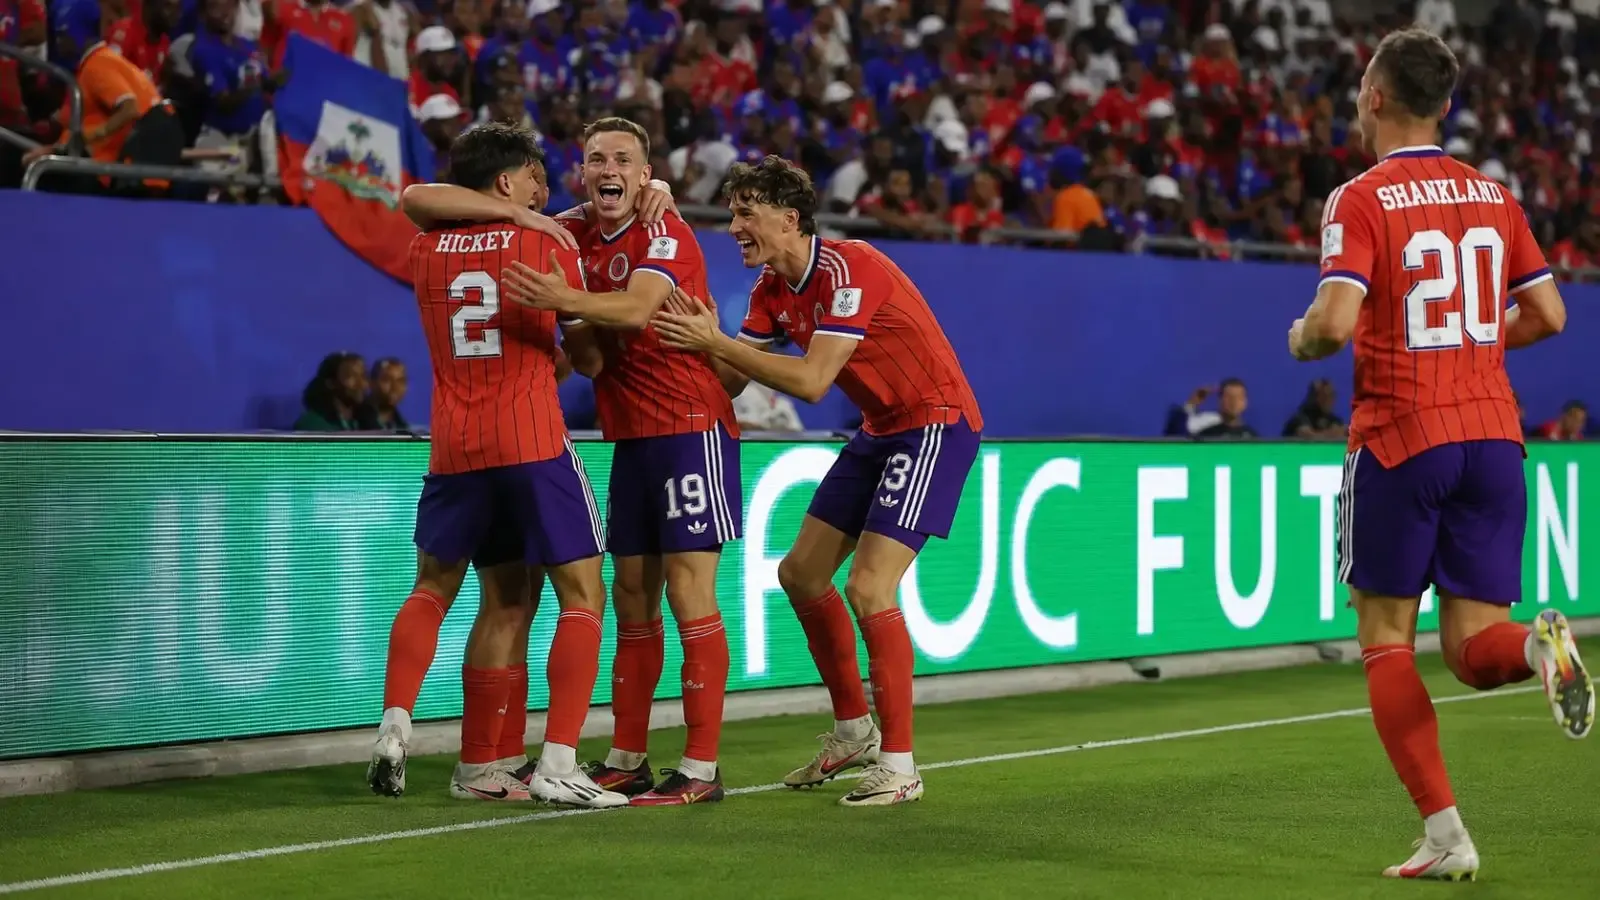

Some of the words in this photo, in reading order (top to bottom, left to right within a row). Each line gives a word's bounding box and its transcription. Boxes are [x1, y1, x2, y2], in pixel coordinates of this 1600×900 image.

[1376, 179, 1504, 211] SHANKLAND
[435, 231, 515, 253] HICKEY
[1402, 226, 1505, 352] 20
[447, 270, 502, 360] 2
[877, 453, 913, 491] 3
[664, 473, 708, 520] 19
